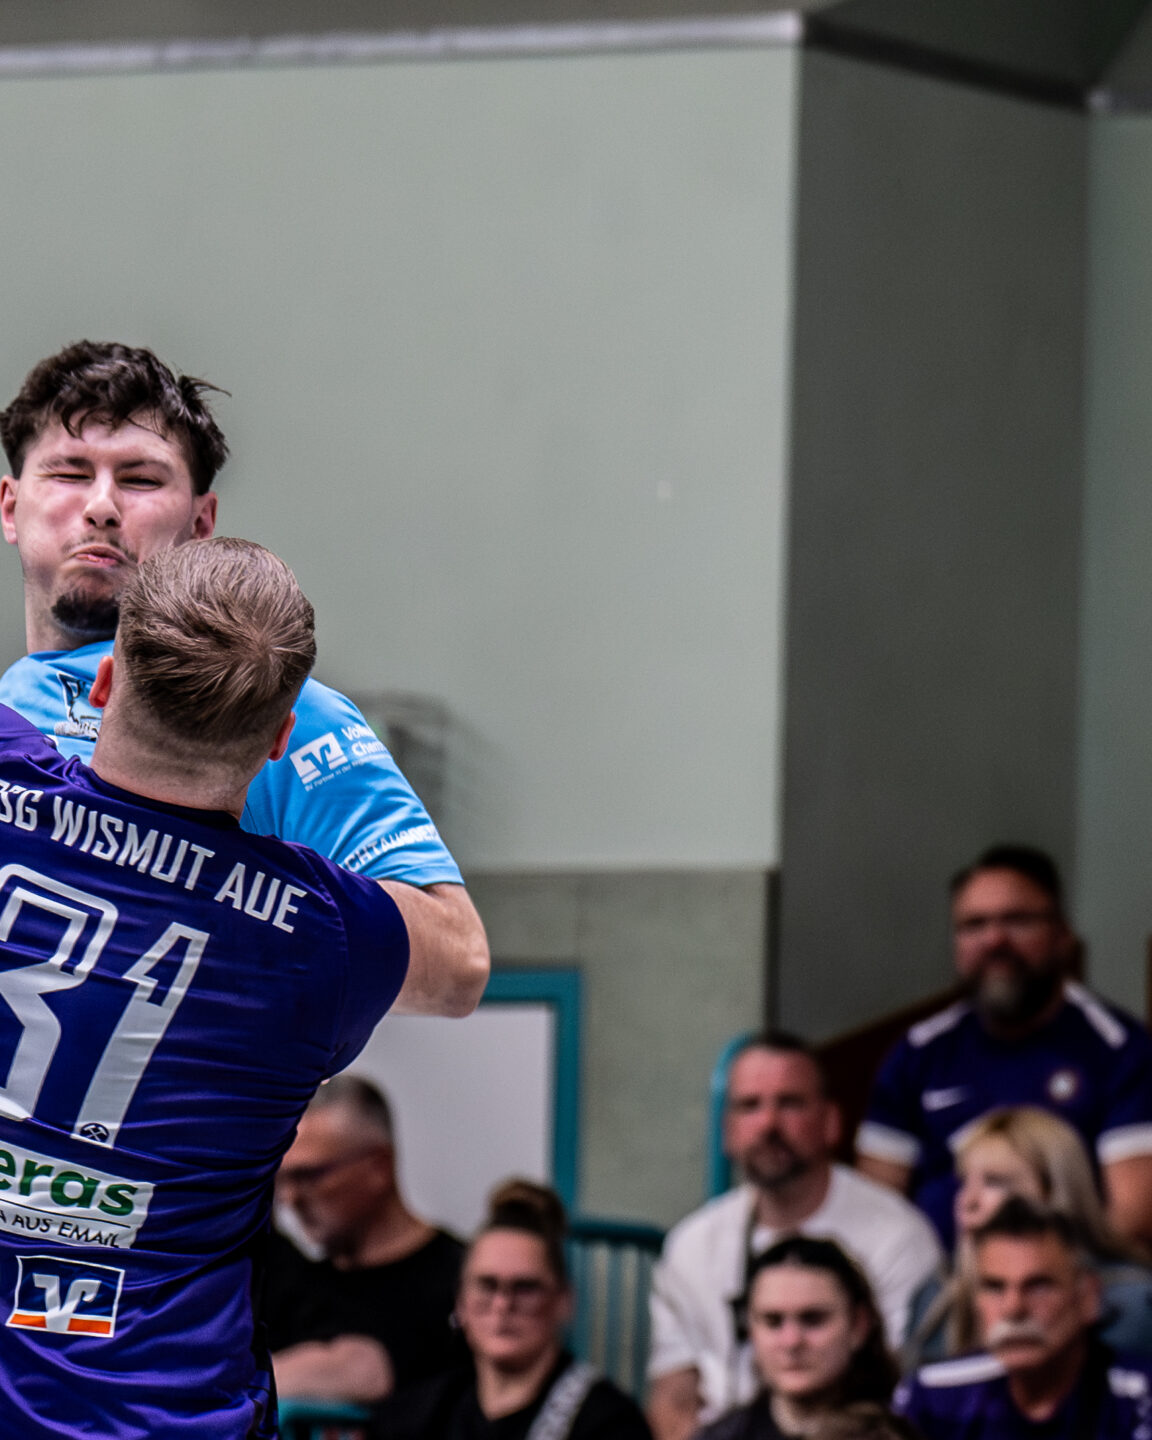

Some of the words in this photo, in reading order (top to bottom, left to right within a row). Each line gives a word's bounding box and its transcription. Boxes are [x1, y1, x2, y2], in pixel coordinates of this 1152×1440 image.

[50, 795, 216, 891] WISMUT
[214, 862, 308, 934] AUE
[12, 1214, 54, 1233] AUS
[57, 1224, 120, 1249] EMAIL
